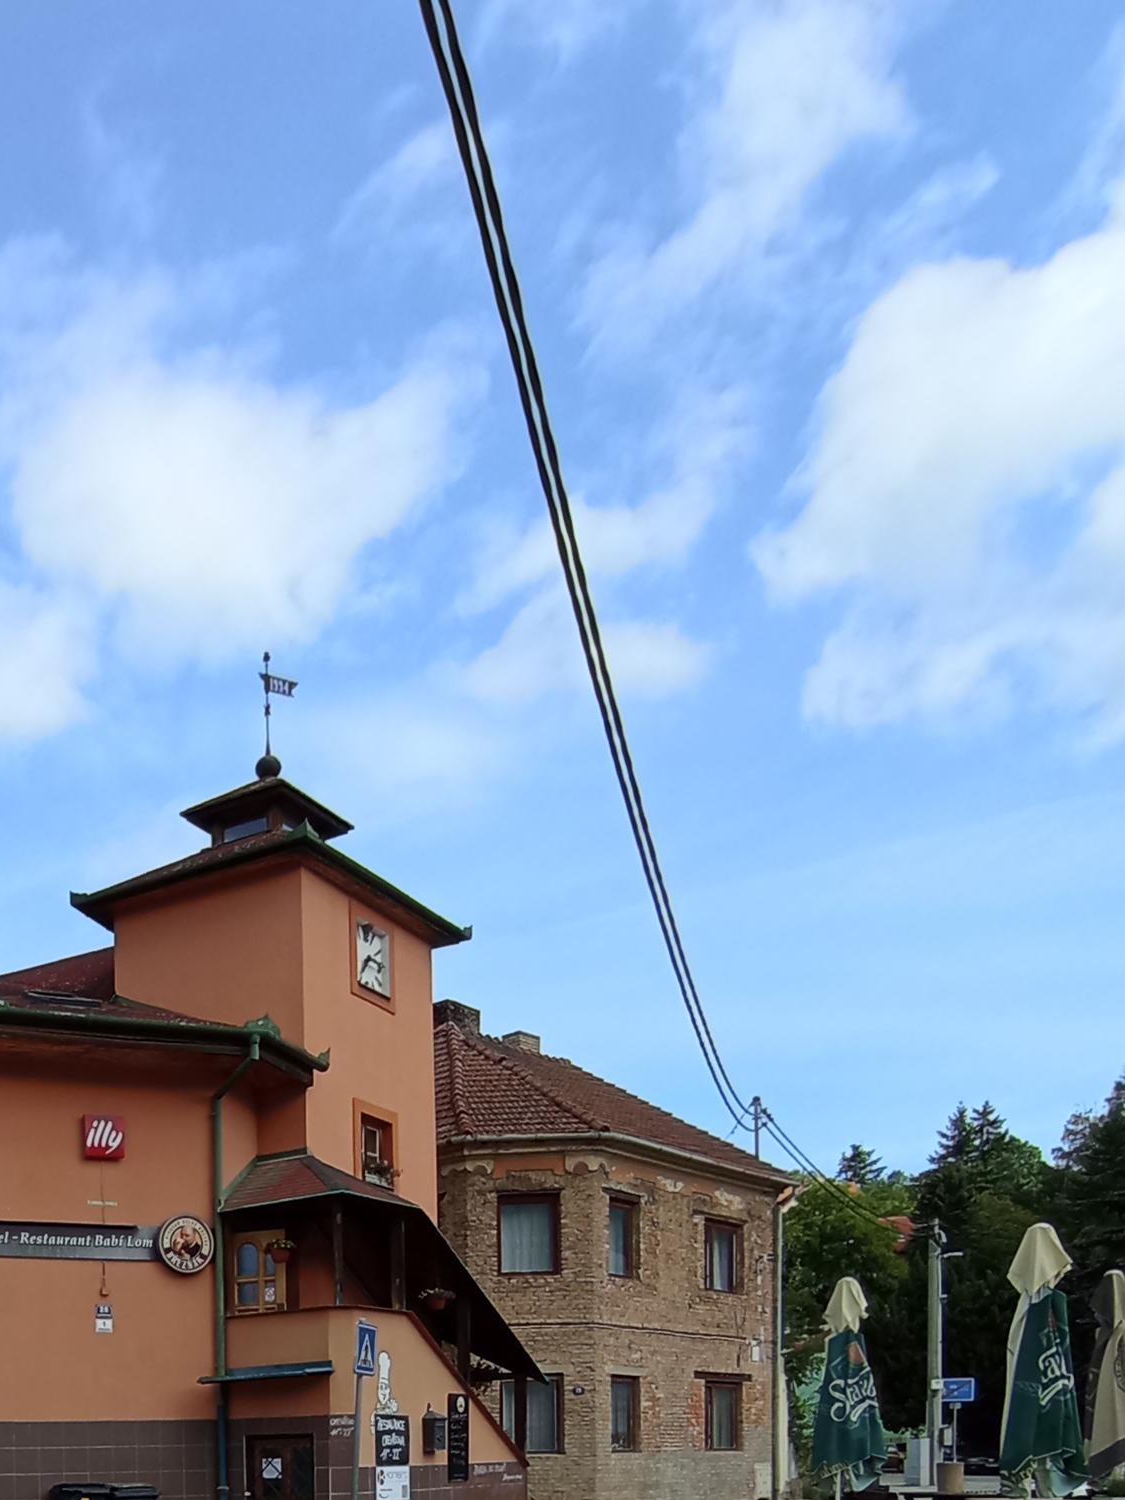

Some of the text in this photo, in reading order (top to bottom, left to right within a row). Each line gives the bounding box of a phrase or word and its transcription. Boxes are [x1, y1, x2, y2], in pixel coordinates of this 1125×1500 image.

[86, 1119, 123, 1155] illy
[94, 1233, 125, 1248] Babí
[126, 1235, 154, 1249] Lom
